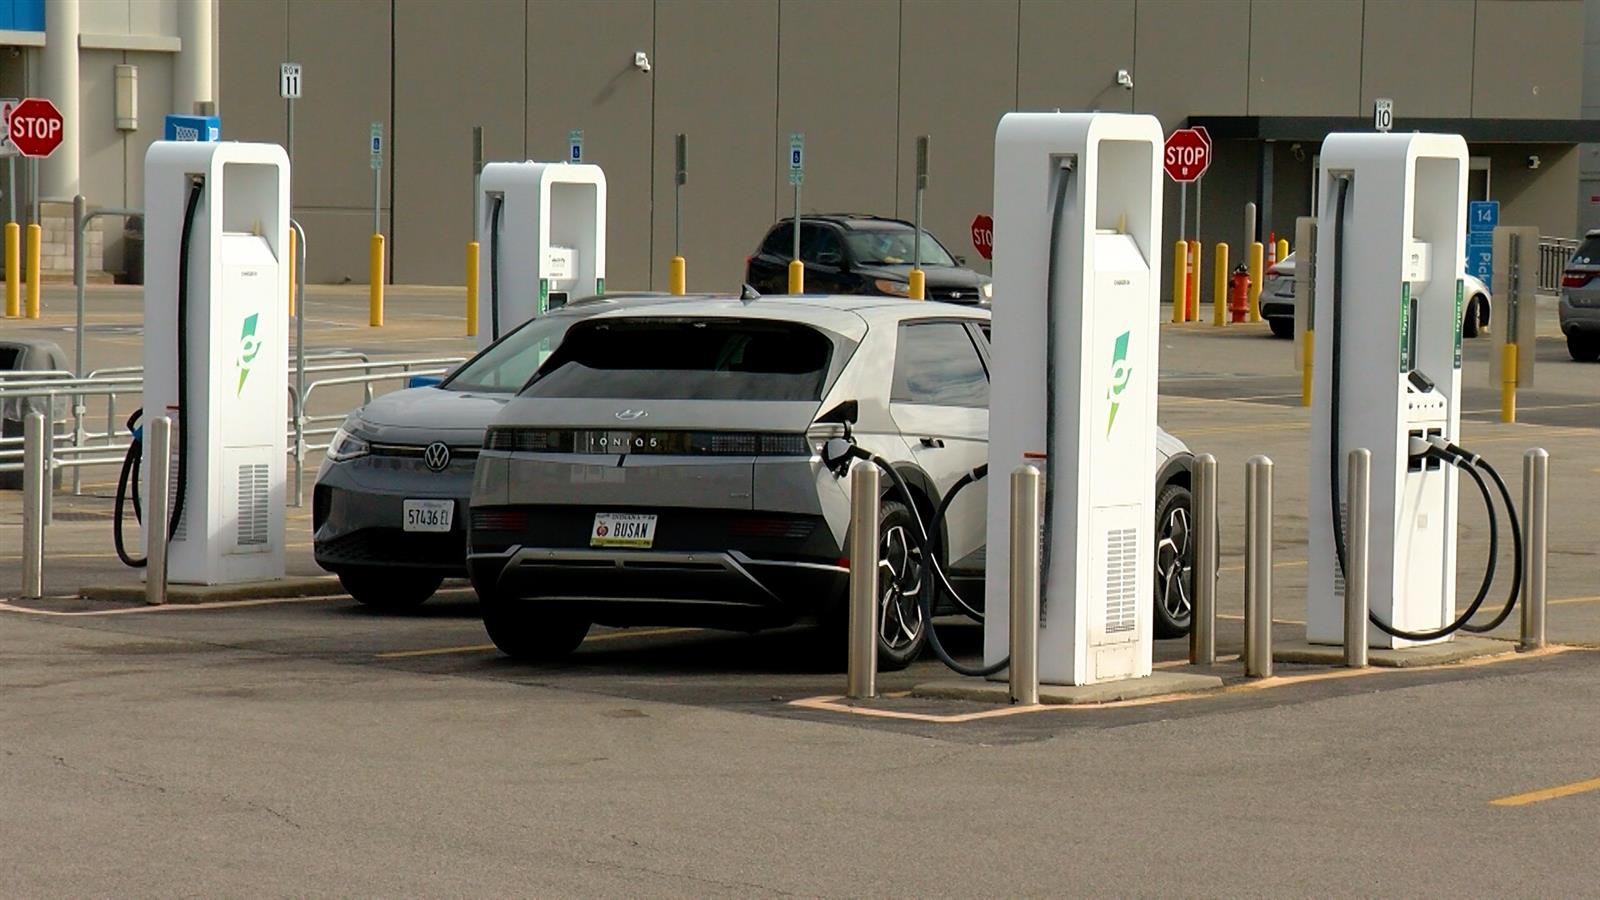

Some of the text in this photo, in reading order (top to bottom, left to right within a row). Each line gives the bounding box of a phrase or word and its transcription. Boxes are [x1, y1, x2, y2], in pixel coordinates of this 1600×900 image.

[284, 66, 299, 75] ROW
[286, 76, 297, 95] 11
[1378, 109, 1390, 127] 10
[13, 116, 61, 139] STOP
[1166, 146, 1204, 166] STOP
[1478, 208, 1492, 223] 14
[973, 228, 993, 247] STO
[408, 509, 438, 525] 57436
[613, 522, 648, 538] BUSAN
